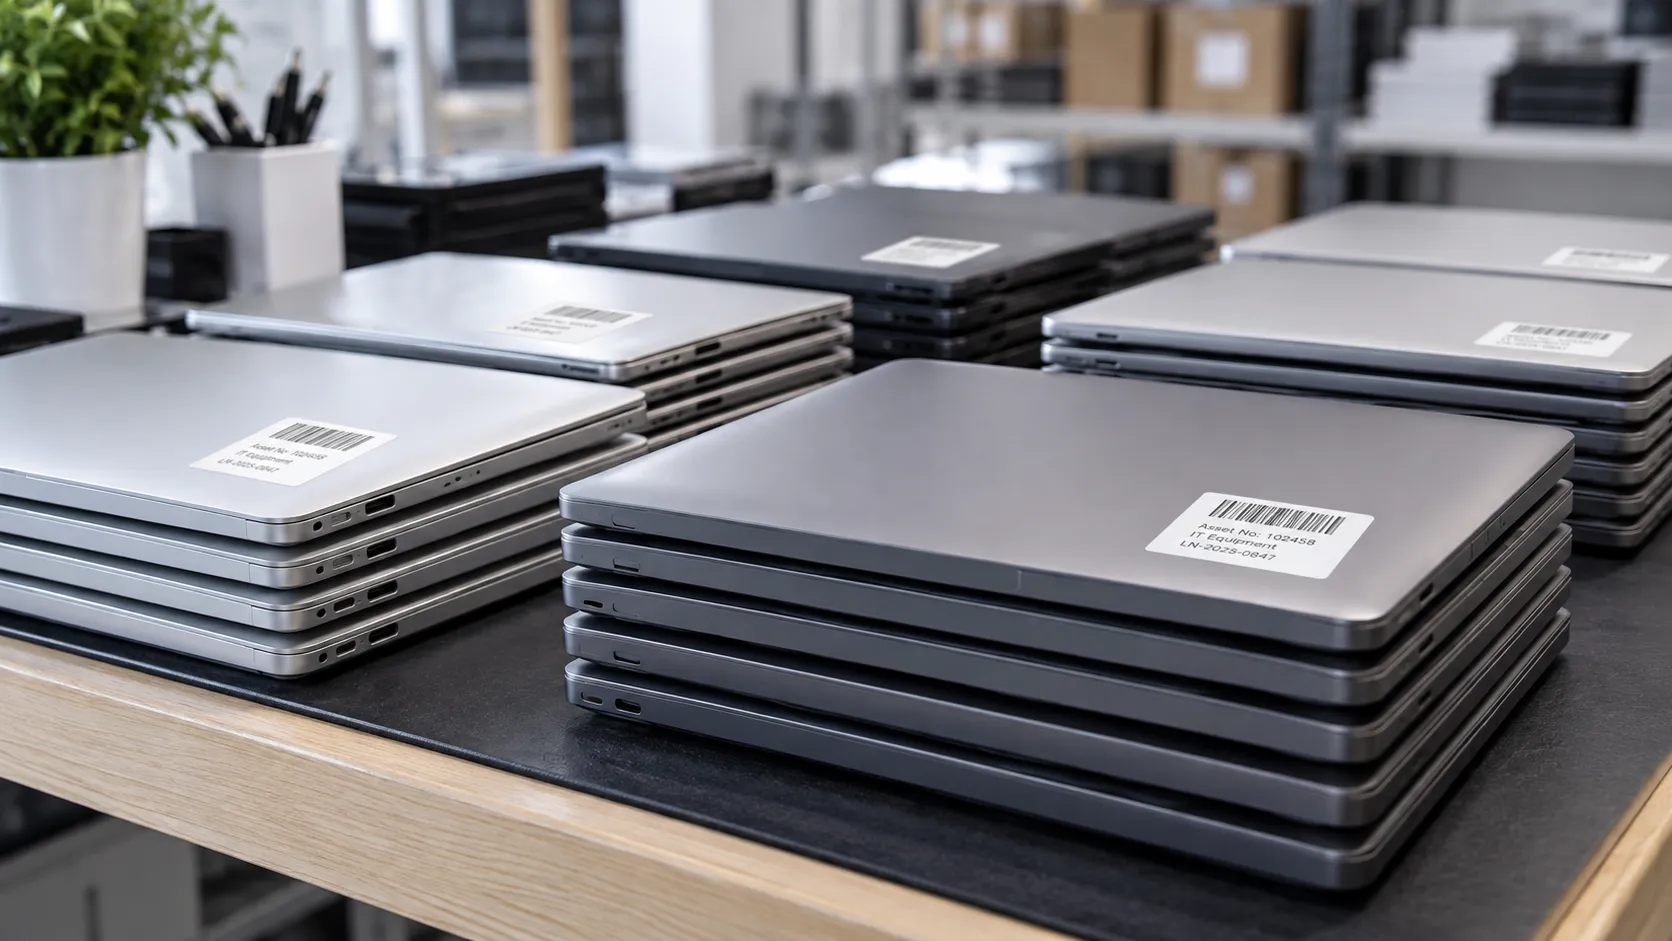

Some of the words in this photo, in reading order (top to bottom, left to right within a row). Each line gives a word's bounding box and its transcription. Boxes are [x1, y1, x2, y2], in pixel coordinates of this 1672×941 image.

[1189, 531, 1205, 539] IT
[1207, 533, 1278, 551] Equipment
[1198, 523, 1235, 534] Asset
[1238, 529, 1261, 538] No:
[1267, 533, 1316, 546] 102458
[1179, 540, 1276, 561] LN-2025-0847
